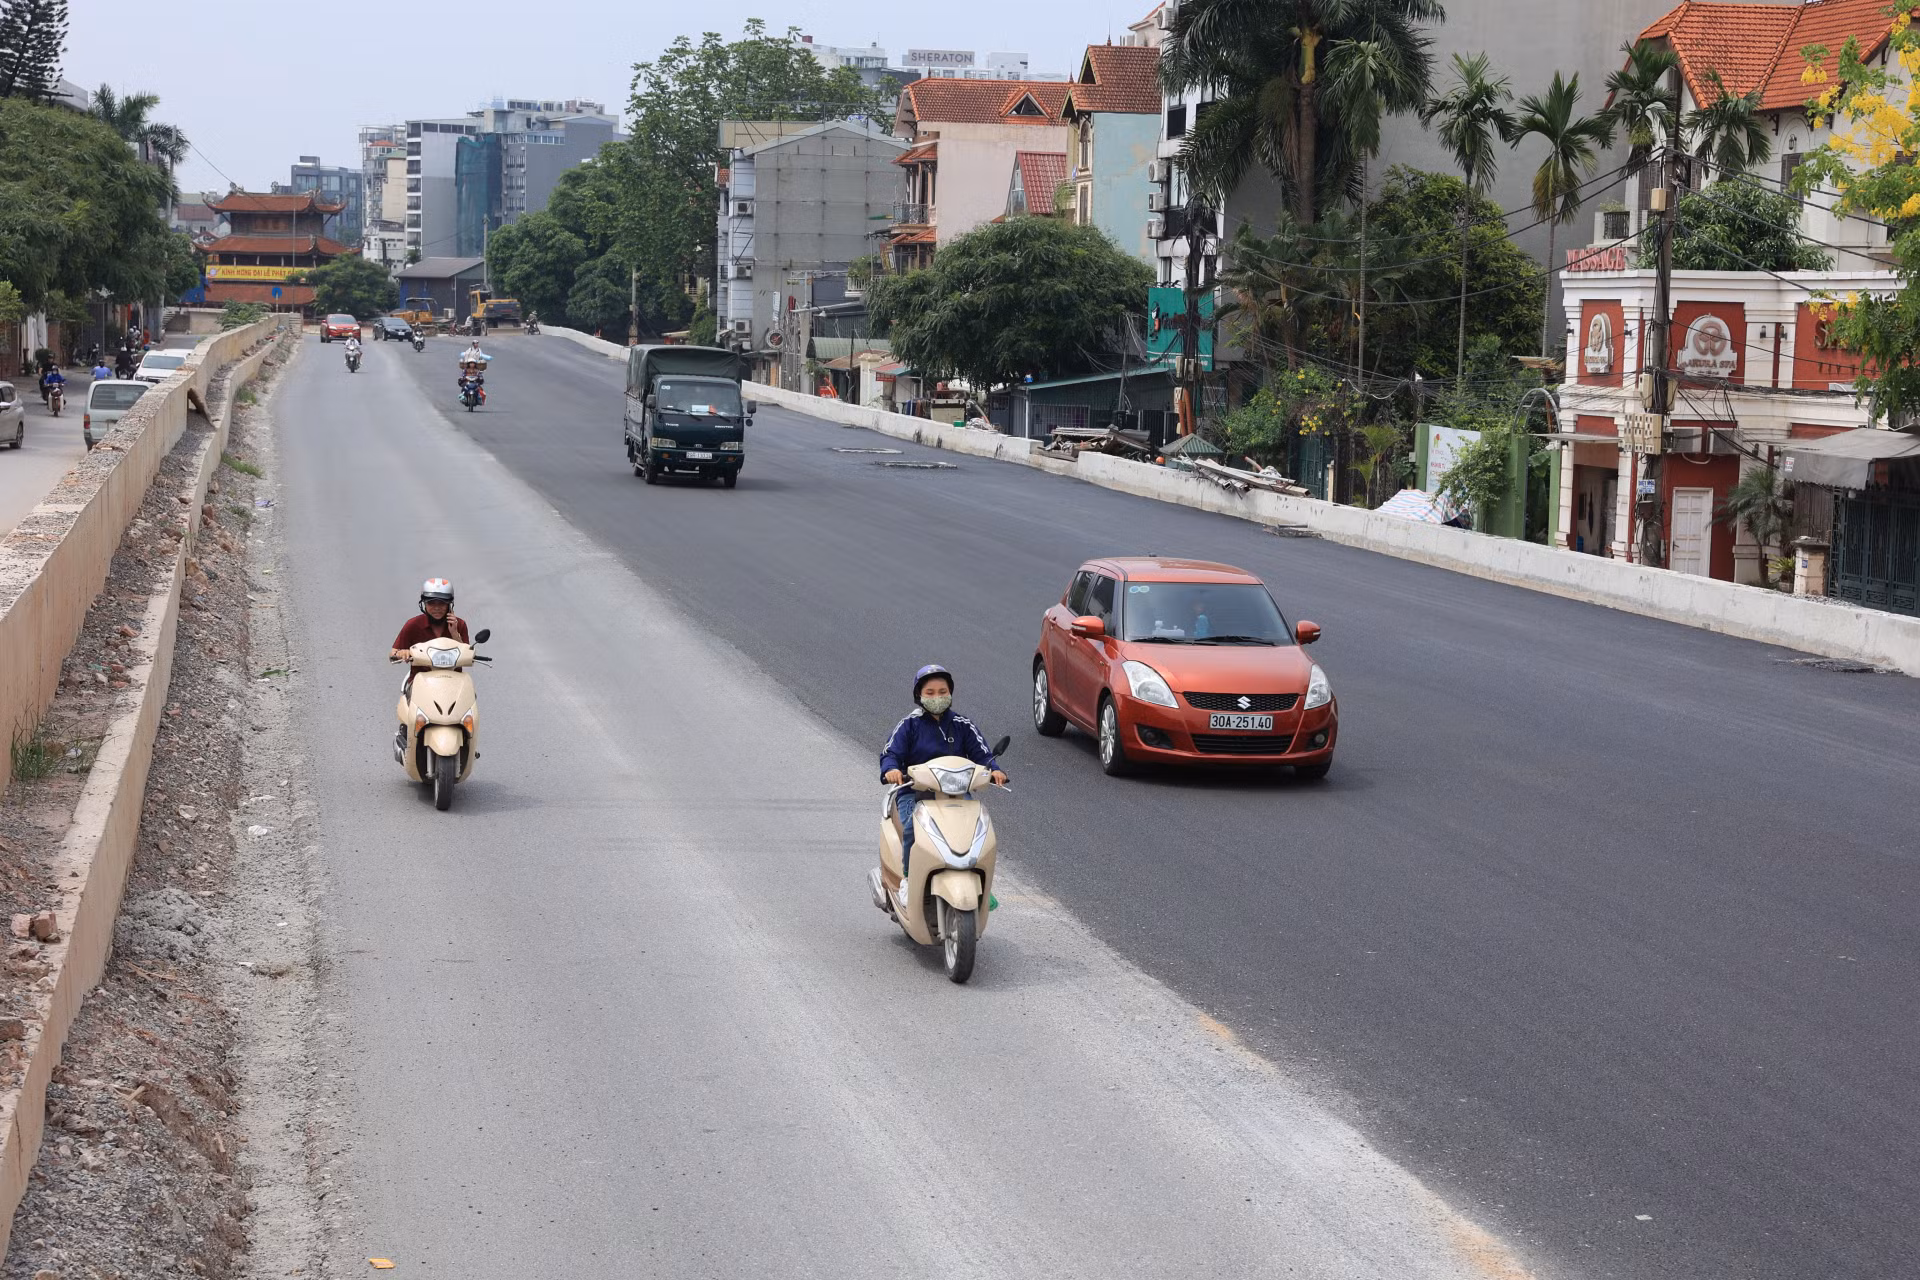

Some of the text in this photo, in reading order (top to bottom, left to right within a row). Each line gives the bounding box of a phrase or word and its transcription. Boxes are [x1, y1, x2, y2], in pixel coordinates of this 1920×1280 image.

[911, 52, 972, 63] SHERATON
[1566, 247, 1625, 272] MASSAGE
[1211, 715, 1272, 729] 30A-251.40
